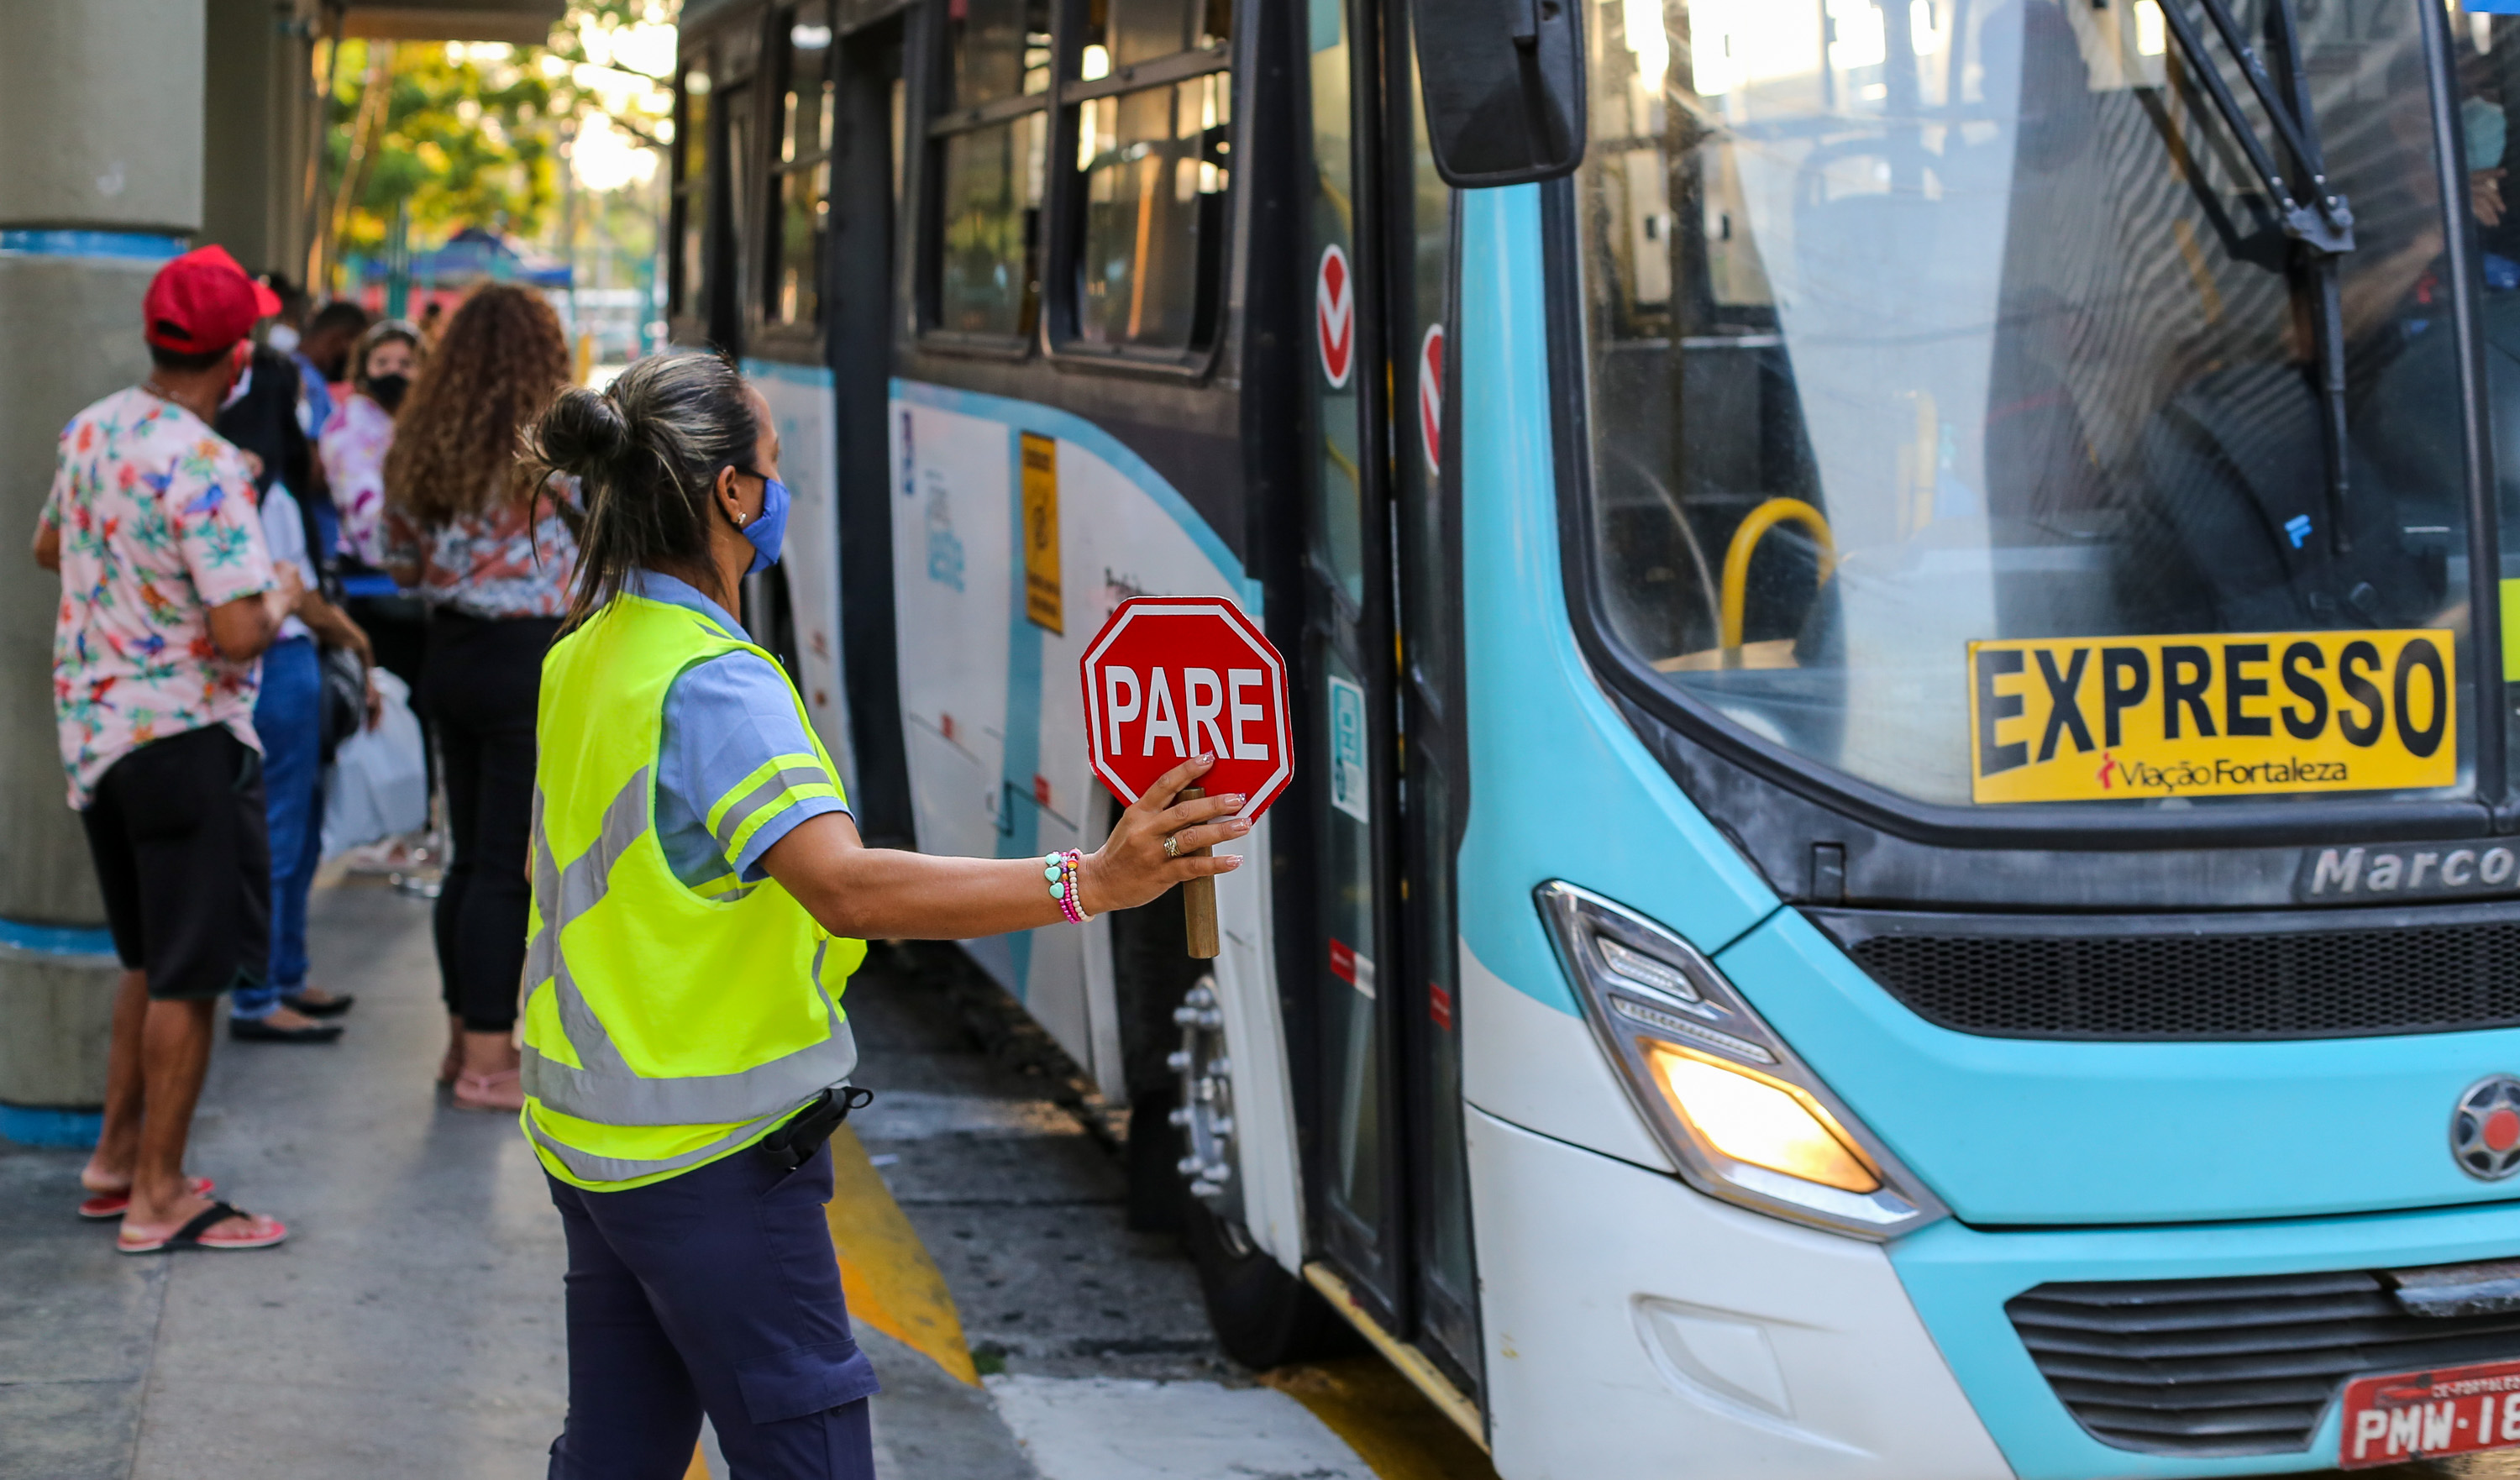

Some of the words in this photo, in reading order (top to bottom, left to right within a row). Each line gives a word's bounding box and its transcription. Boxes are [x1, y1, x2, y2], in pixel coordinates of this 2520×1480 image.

[1105, 665, 1269, 761] PARE
[1975, 638, 2448, 778] EXPRESSO
[2118, 760, 2213, 793] Viação
[2214, 756, 2348, 785] Fortaleza
[2311, 847, 2520, 895] Marco
